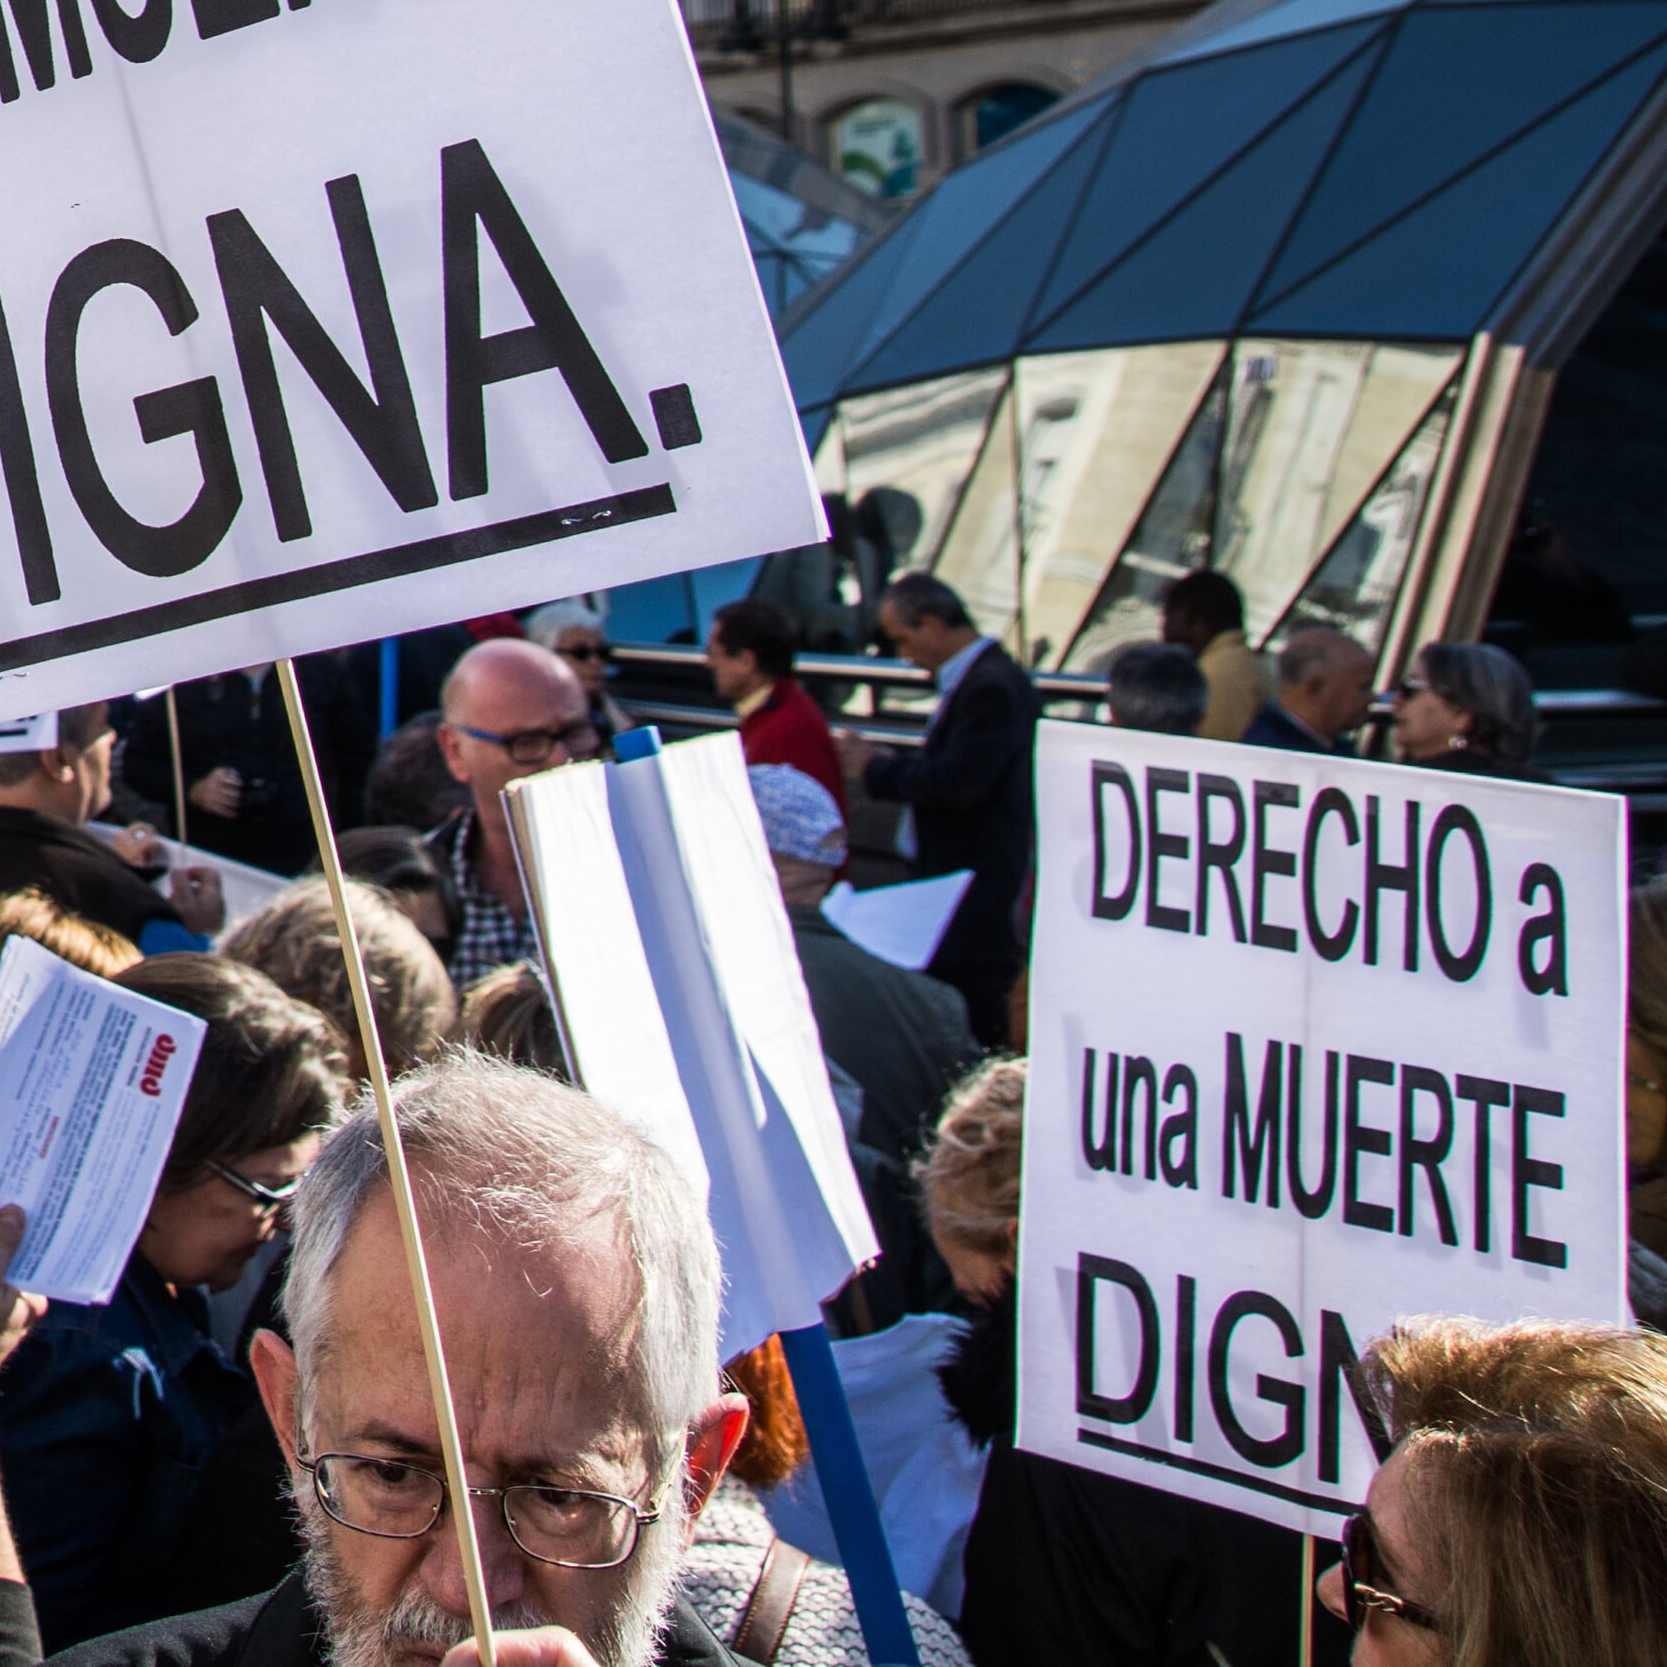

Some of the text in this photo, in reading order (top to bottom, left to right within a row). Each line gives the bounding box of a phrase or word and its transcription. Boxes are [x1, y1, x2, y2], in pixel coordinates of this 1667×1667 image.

[1091, 760, 1569, 997] DERECHO a
[1082, 1031, 1569, 1269] una MUERTE
[1076, 1250, 1392, 1484] DIGN
